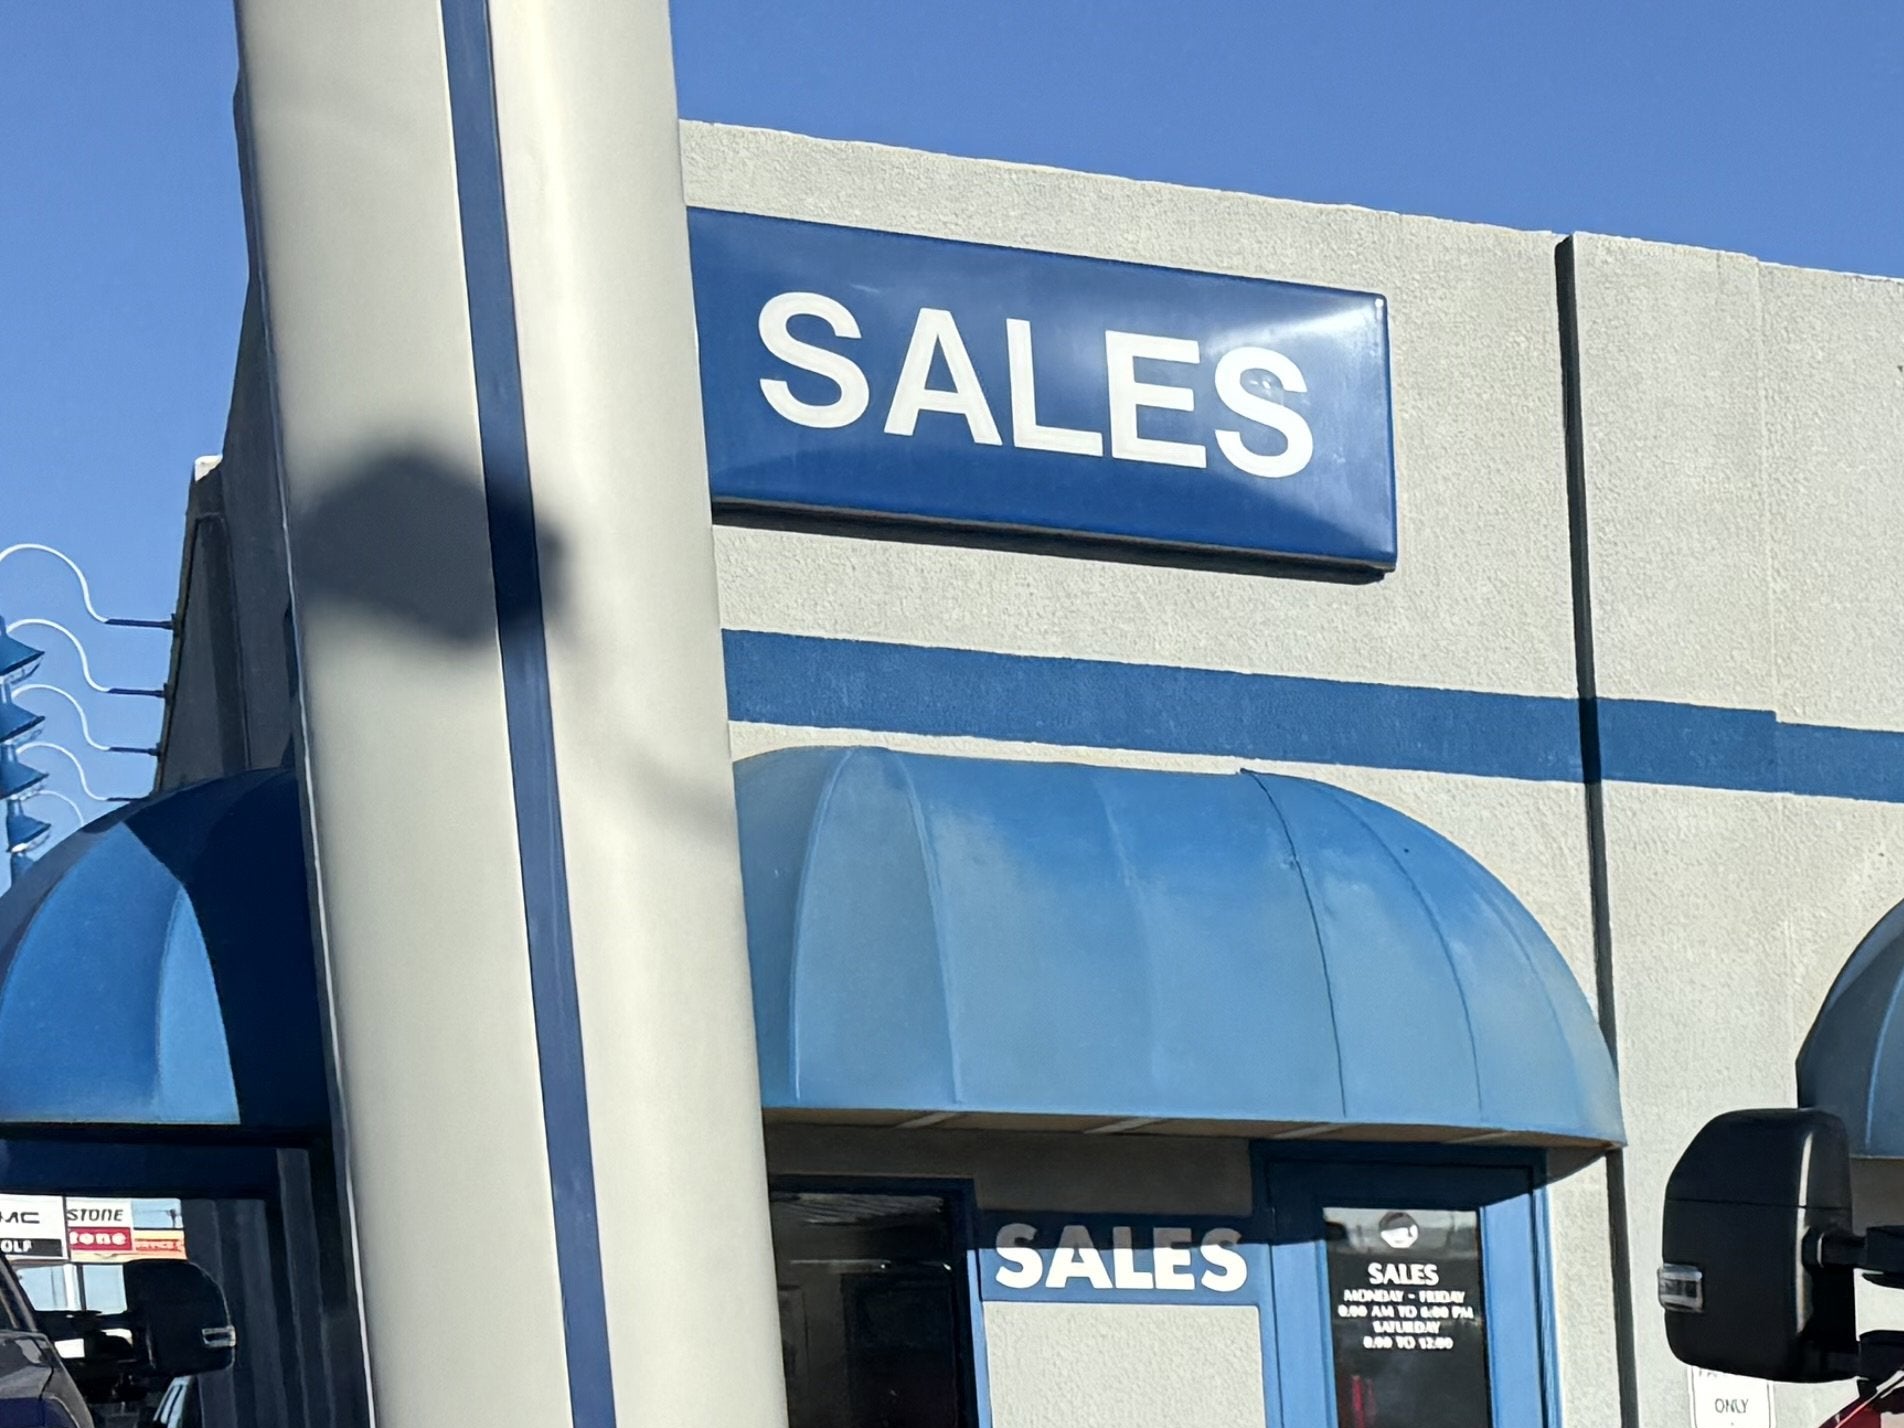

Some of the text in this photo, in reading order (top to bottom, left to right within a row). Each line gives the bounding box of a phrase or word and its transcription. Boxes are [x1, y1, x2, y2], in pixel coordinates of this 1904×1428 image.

[758, 291, 1315, 479] SALES
[0, 1212, 40, 1224] MC
[66, 1208, 124, 1222] STONE
[0, 1239, 32, 1253] OLF
[995, 1223, 1248, 1292] SALES
[1367, 1262, 1439, 1286] SALES
[1343, 1288, 1404, 1303] MONDAY
[1418, 1290, 1466, 1303] FRIDAY
[1371, 1304, 1395, 1318] AM
[1397, 1305, 1418, 1319] TO
[1451, 1306, 1474, 1319] PM
[1395, 1335, 1416, 1350] TO
[1714, 1397, 1749, 1414] ONLY
